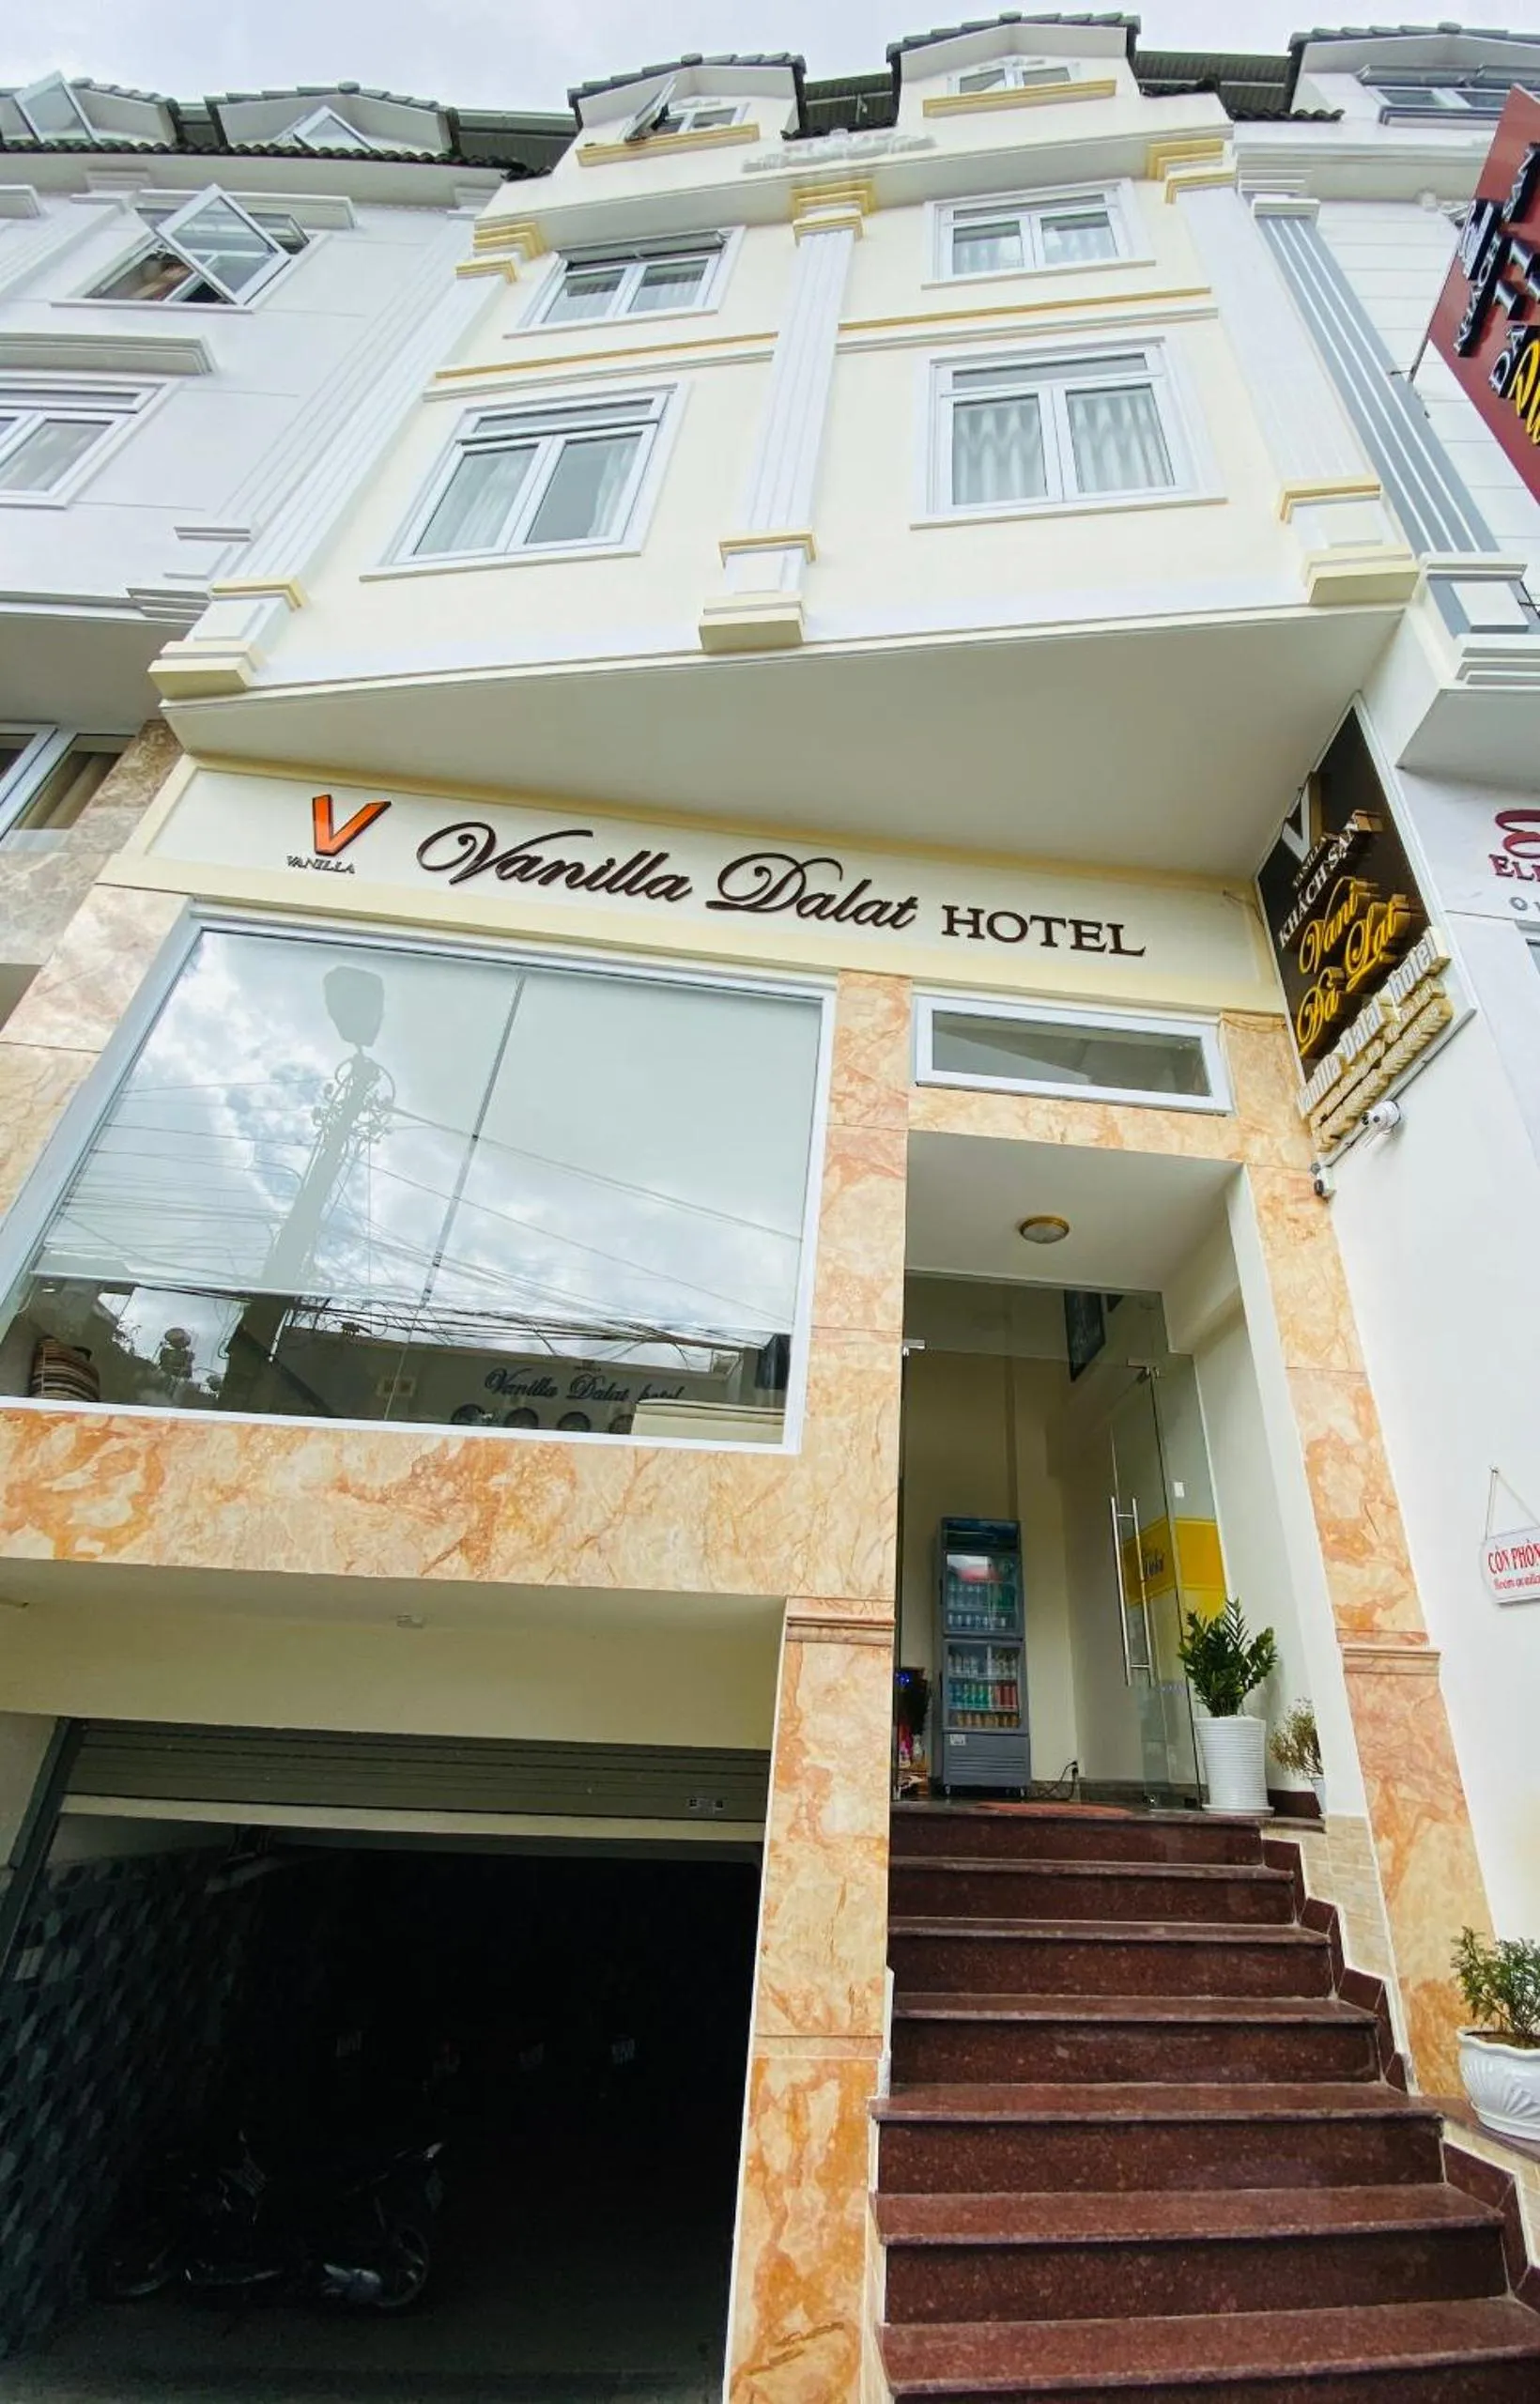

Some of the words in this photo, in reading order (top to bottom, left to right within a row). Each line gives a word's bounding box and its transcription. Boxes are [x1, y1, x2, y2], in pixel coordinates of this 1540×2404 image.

[313, 794, 392, 856] V
[286, 855, 355, 874] VANILLA
[416, 821, 693, 903] Vanilla
[705, 852, 918, 931] Dalat
[941, 904, 1147, 957] HOTEL
[1279, 862, 1328, 949] KHÁCH
[484, 1368, 559, 1398] Vanilla
[566, 1373, 629, 1401] Dalat
